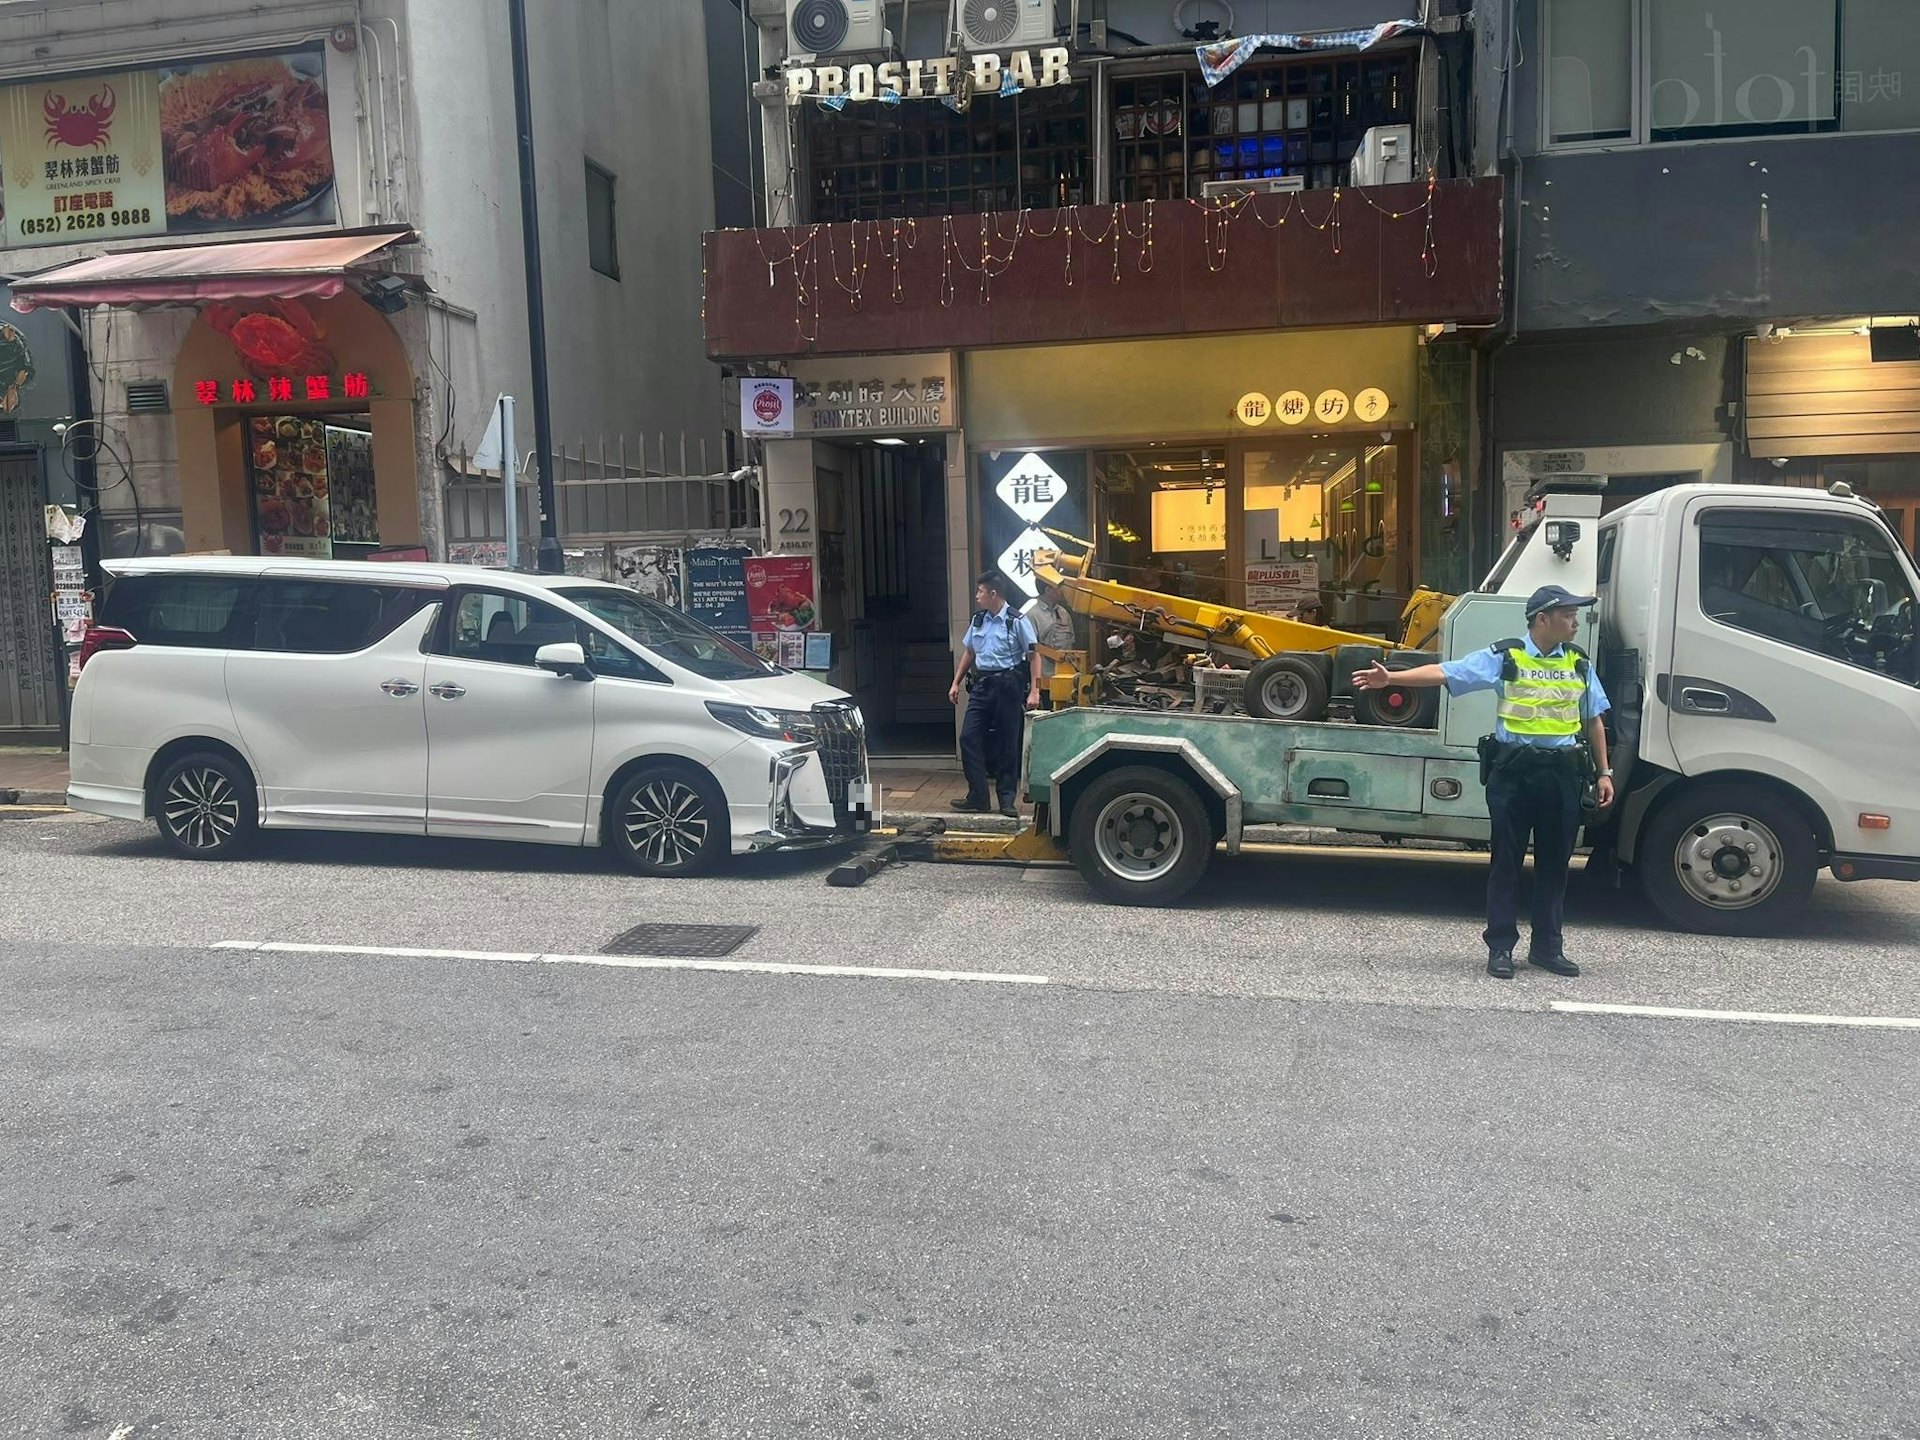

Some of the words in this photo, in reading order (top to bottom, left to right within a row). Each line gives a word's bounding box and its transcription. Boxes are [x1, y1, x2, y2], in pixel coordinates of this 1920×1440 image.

[786, 57, 957, 101] PROSIT
[972, 47, 1071, 92] BAR
[45, 155, 119, 180] 翠林辣蟹舫
[46, 181, 83, 190] GREENLAND
[104, 177, 121, 185] CRAB
[53, 191, 114, 213] 訂座電話
[20, 216, 61, 235] (852)
[67, 213, 105, 230] 2628
[111, 208, 151, 226] 9888
[195, 373, 369, 405] 翠林辣蟹舫
[812, 408, 872, 428] HONYTEX
[879, 406, 940, 426] BUILDING
[779, 508, 810, 533] 22
[780, 541, 814, 549] ASHLEY
[692, 558, 717, 566] Matin
[723, 558, 741, 566] Kim
[1531, 670, 1566, 680] POLICE
